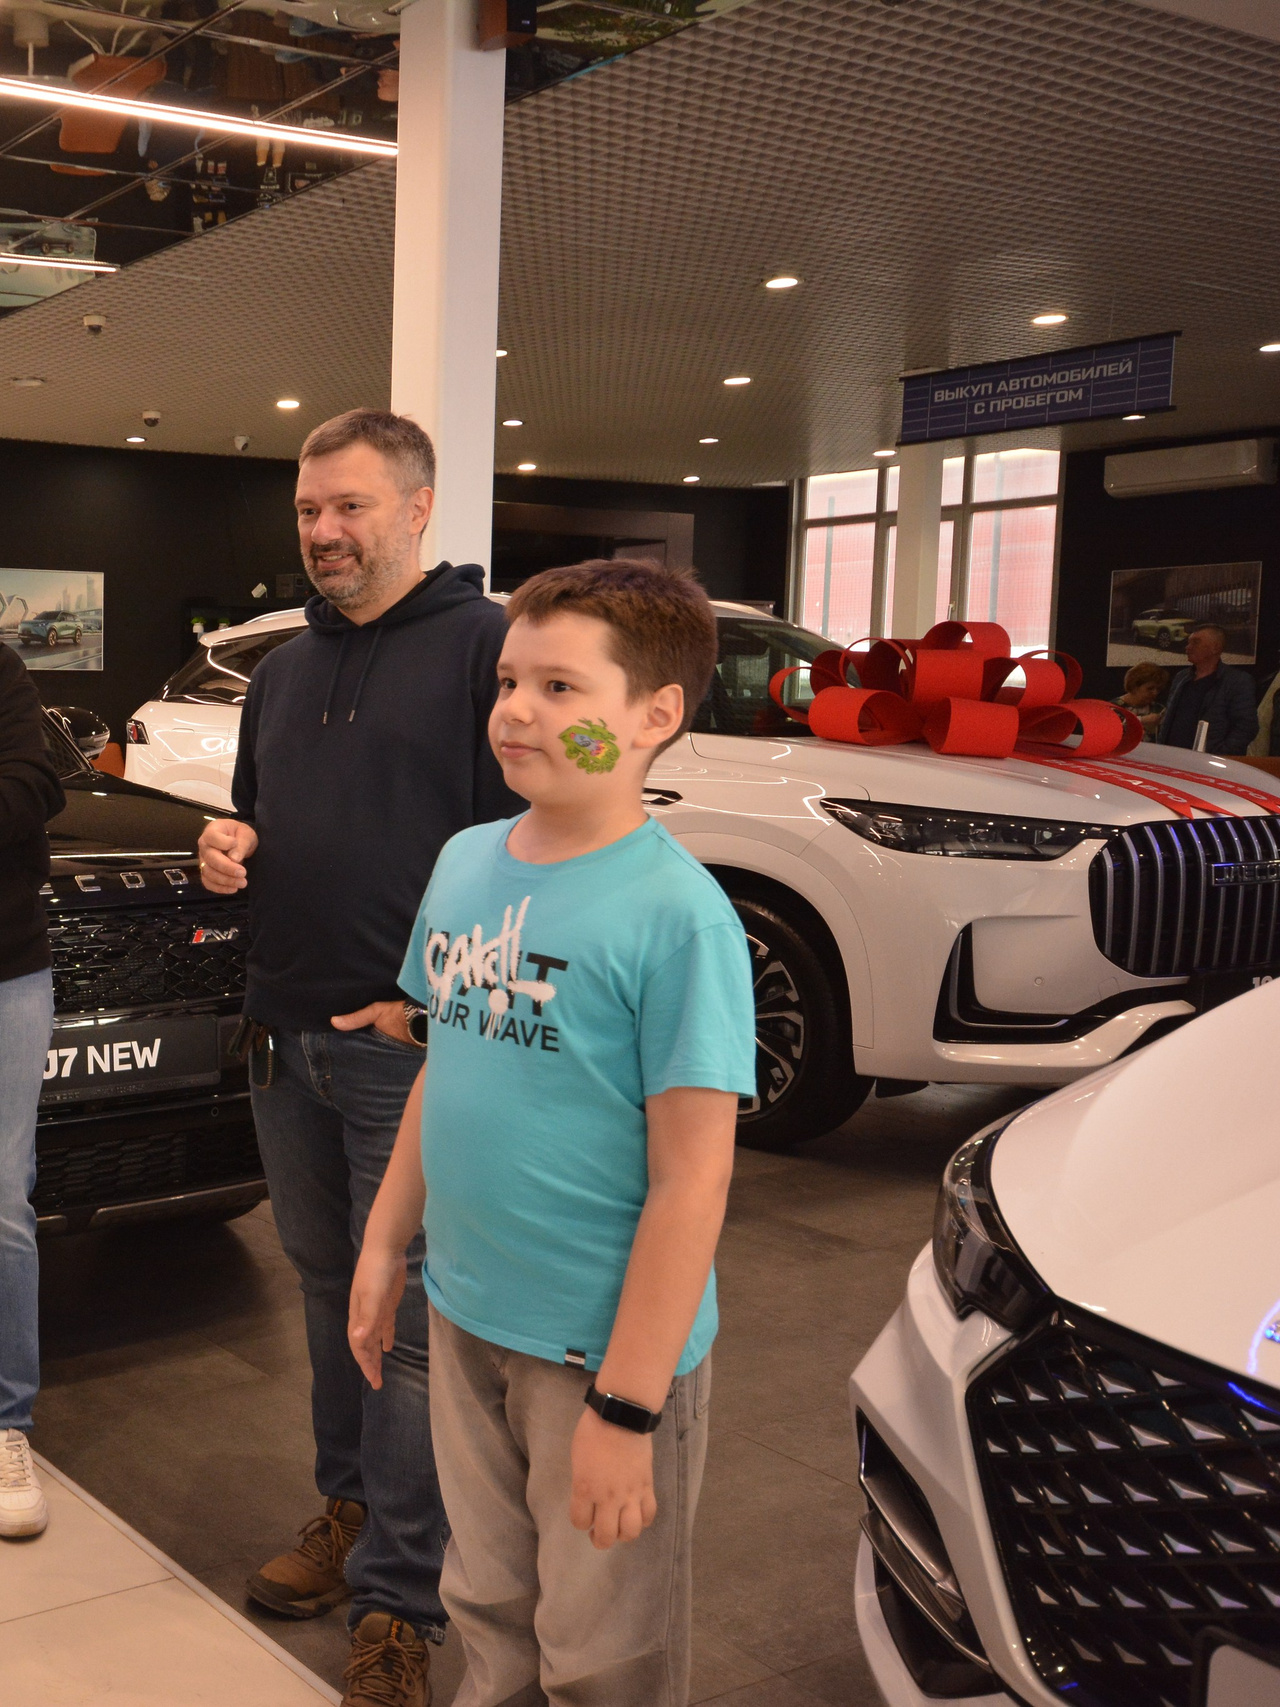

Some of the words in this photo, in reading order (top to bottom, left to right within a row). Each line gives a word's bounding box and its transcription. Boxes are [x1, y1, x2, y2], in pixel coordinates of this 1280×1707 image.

[934, 382, 993, 403] ВЫКУП
[996, 358, 1133, 393] АВТОМОБИЛЕЙ
[973, 402, 986, 415] С
[989, 388, 1083, 413] ПРОБЕГОМ
[43, 1047, 78, 1080] J7
[87, 1038, 162, 1075] NEW
